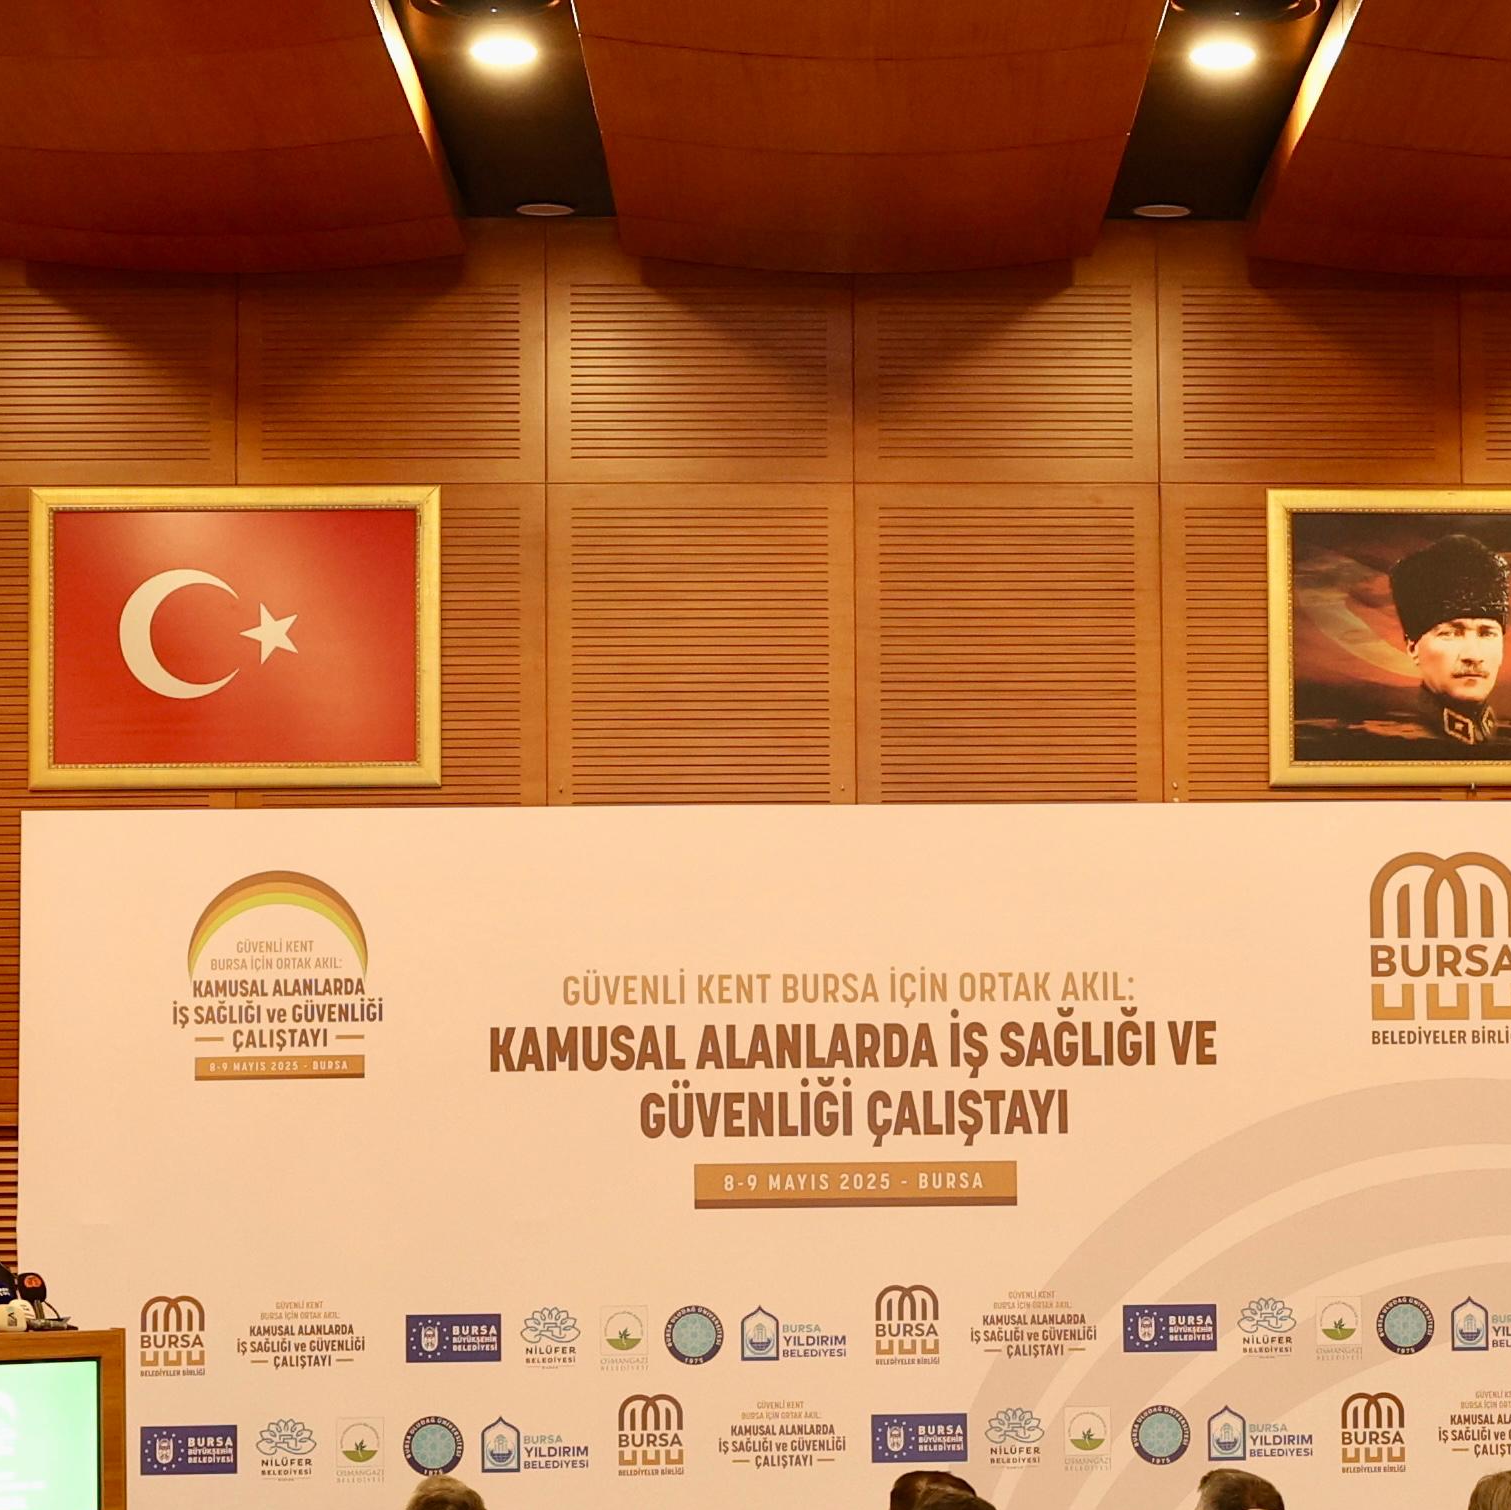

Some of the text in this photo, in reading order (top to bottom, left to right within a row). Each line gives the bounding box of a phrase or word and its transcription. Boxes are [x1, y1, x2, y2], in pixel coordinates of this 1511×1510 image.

[237, 938, 314, 953] GÜVENLİ KENT
[211, 956, 342, 972] BURSA İÇİN ORTAK AKIL:
[192, 978, 365, 998] KAMUSAL ALANLARDA
[562, 966, 1134, 1008] GÜVENLİ KENT BURSA İÇİN ORTAK AKIL:
[172, 998, 383, 1028] İŞ SAĞLIĞI ve GÜVENLİĞİ
[232, 1028, 328, 1052] ÇALIŞTAYI
[490, 1007, 1217, 1078] KAMUSAL ALANLARDA İŞ SAĞLIĞI VE
[1372, 1026, 1466, 1044] BELEDİYELER
[210, 1062, 228, 1072] 8-9
[233, 1062, 266, 1072] MAYIS
[272, 1061, 298, 1071] 2025
[312, 1061, 348, 1071] BURSA
[640, 1076, 1068, 1147] GÜVENLİĞİ ÇALIŞTAYI
[723, 1175, 758, 1192] 8-9
[768, 1174, 830, 1192] MAYIS
[840, 1173, 891, 1190] 2025
[918, 1172, 984, 1190] BURSA
[250, 1324, 353, 1337] KAMUSAL ALANLARDA
[452, 1325, 497, 1335] BURSA
[783, 1324, 821, 1332] BURSA
[876, 1323, 938, 1337] BURSA
[140, 1335, 204, 1348] BURSA
[237, 1337, 365, 1355] İŞ SAĞLIĞI ve GÜVENLİĞİ
[784, 1335, 846, 1346] YILDIRIM
[526, 1345, 576, 1354] NİLÜFER
[274, 1355, 331, 1370] ÇALIŞTAYI
[524, 1435, 562, 1444] BURSA
[618, 1433, 682, 1448] BURSA
[1250, 1435, 1312, 1445] YILDIRIM
[1342, 1431, 1404, 1445] BURSA
[525, 1446, 589, 1457] YILDIRIM
